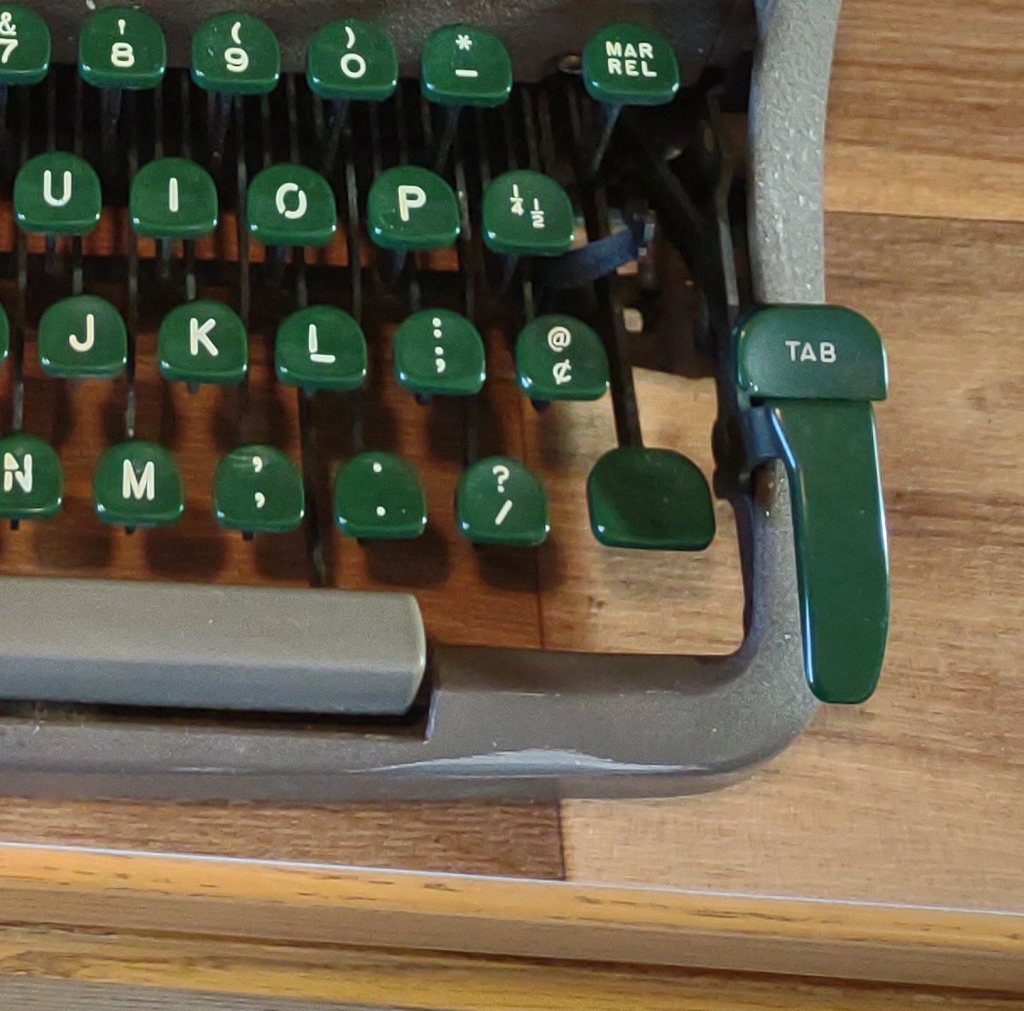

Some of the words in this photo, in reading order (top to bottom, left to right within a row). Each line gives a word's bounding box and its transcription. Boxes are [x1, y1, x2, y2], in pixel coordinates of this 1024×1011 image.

[110, 42, 135, 68] 8
[224, 47, 249, 73] 9
[605, 40, 654, 59] MAR
[607, 57, 658, 78] REL
[43, 169, 72, 207] U
[168, 177, 179, 213] I
[275, 182, 308, 220] O
[397, 184, 427, 222] P
[68, 313, 95, 352] J
[189, 317, 219, 357] K
[308, 323, 336, 364] L
[547, 326, 572, 353] @
[784, 340, 837, 363] TAB
[3, 452, 33, 493] N
[122, 459, 155, 501] M
[492, 464, 510, 493] ?
[494, 499, 513, 526] /
